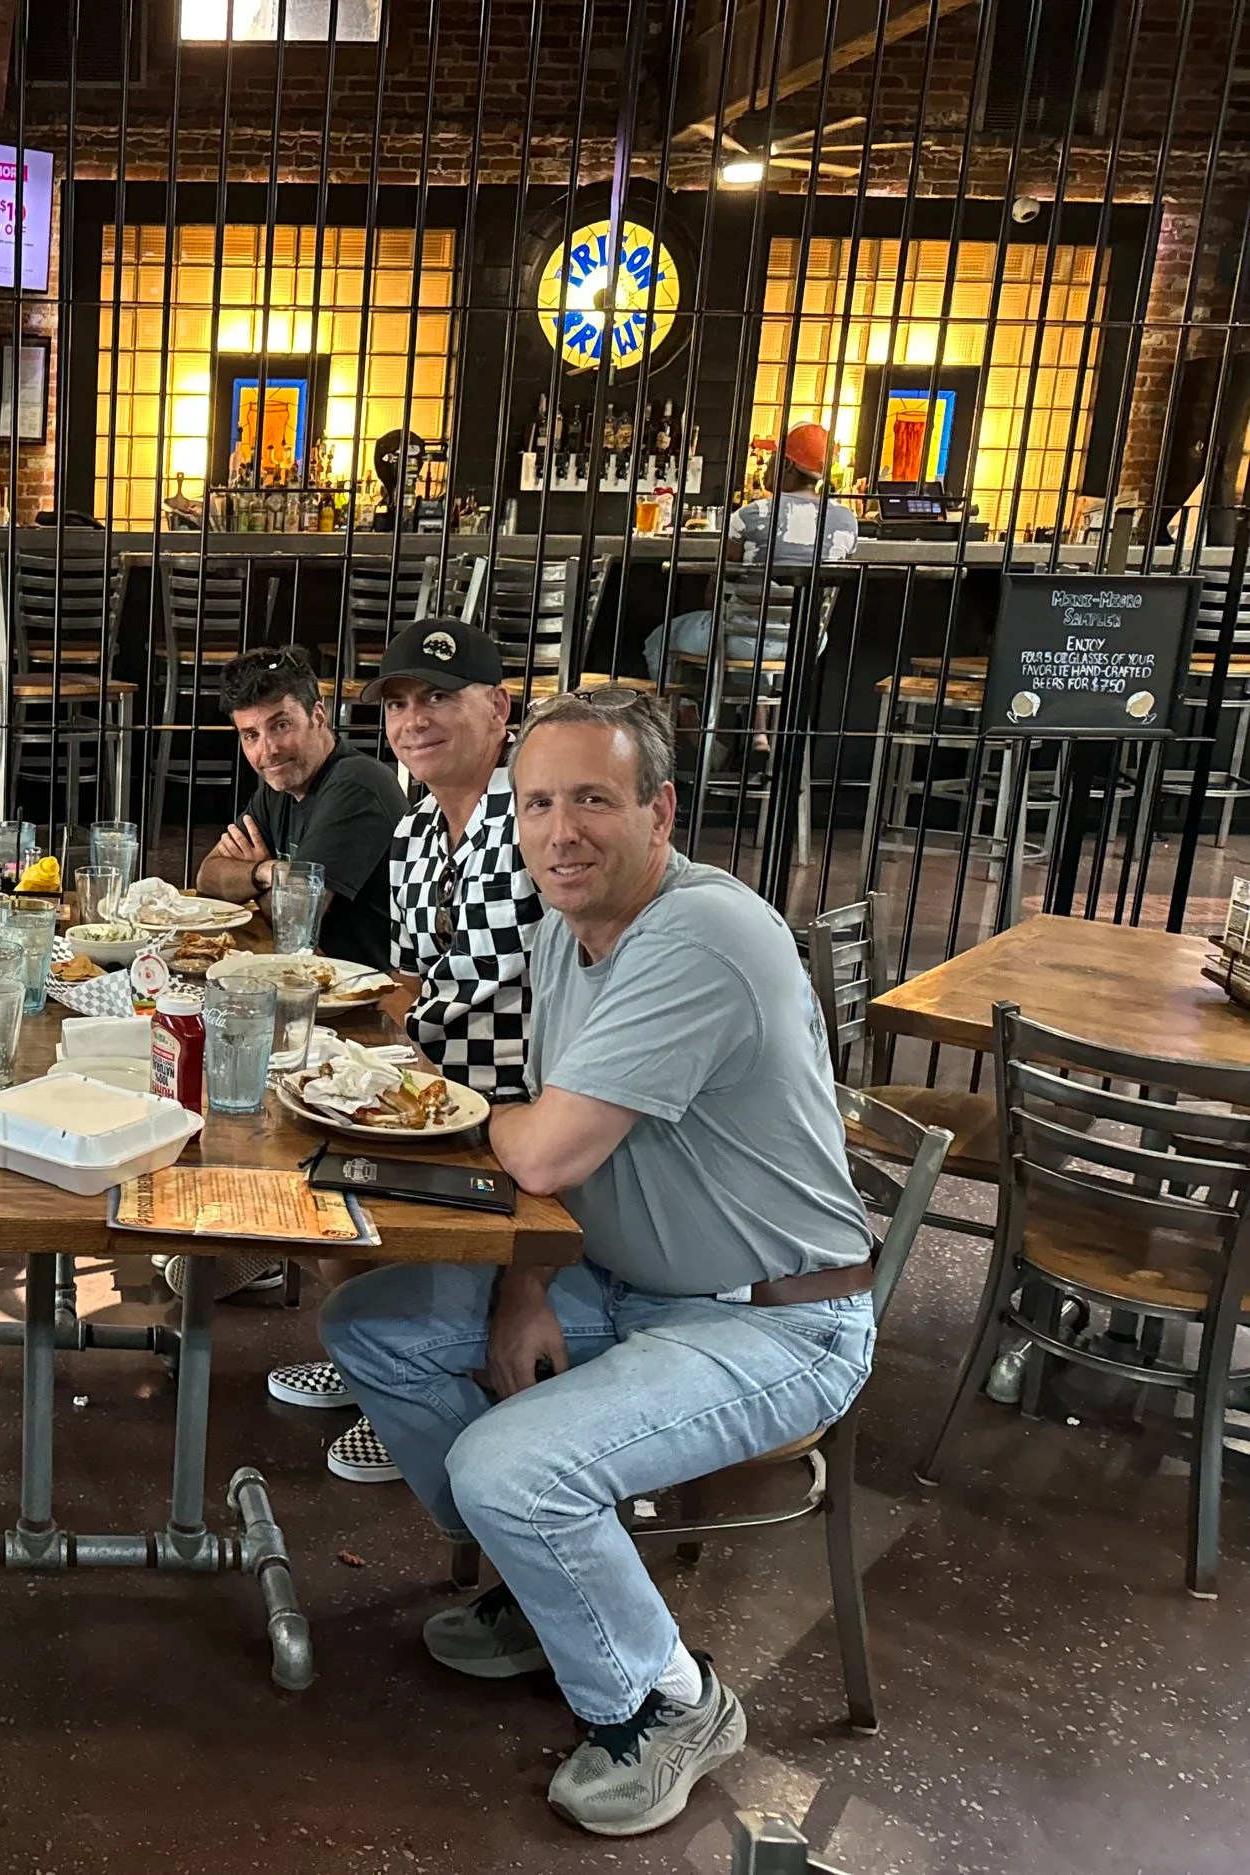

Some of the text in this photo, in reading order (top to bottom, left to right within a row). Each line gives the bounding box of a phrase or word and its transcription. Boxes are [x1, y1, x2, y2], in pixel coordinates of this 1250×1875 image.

[1066, 636, 1106, 651] ENJOY
[1021, 651, 1043, 664] FOUR
[1044, 651, 1052, 663] 5
[1068, 652, 1108, 665] GLASSES
[1110, 653, 1125, 665] OF
[1128, 653, 1155, 667] YOUR
[1022, 663, 1152, 678] FAVORITE HAND-CRAFTED
[1032, 677, 1065, 690] BEERS
[1068, 677, 1089, 690] FOR
